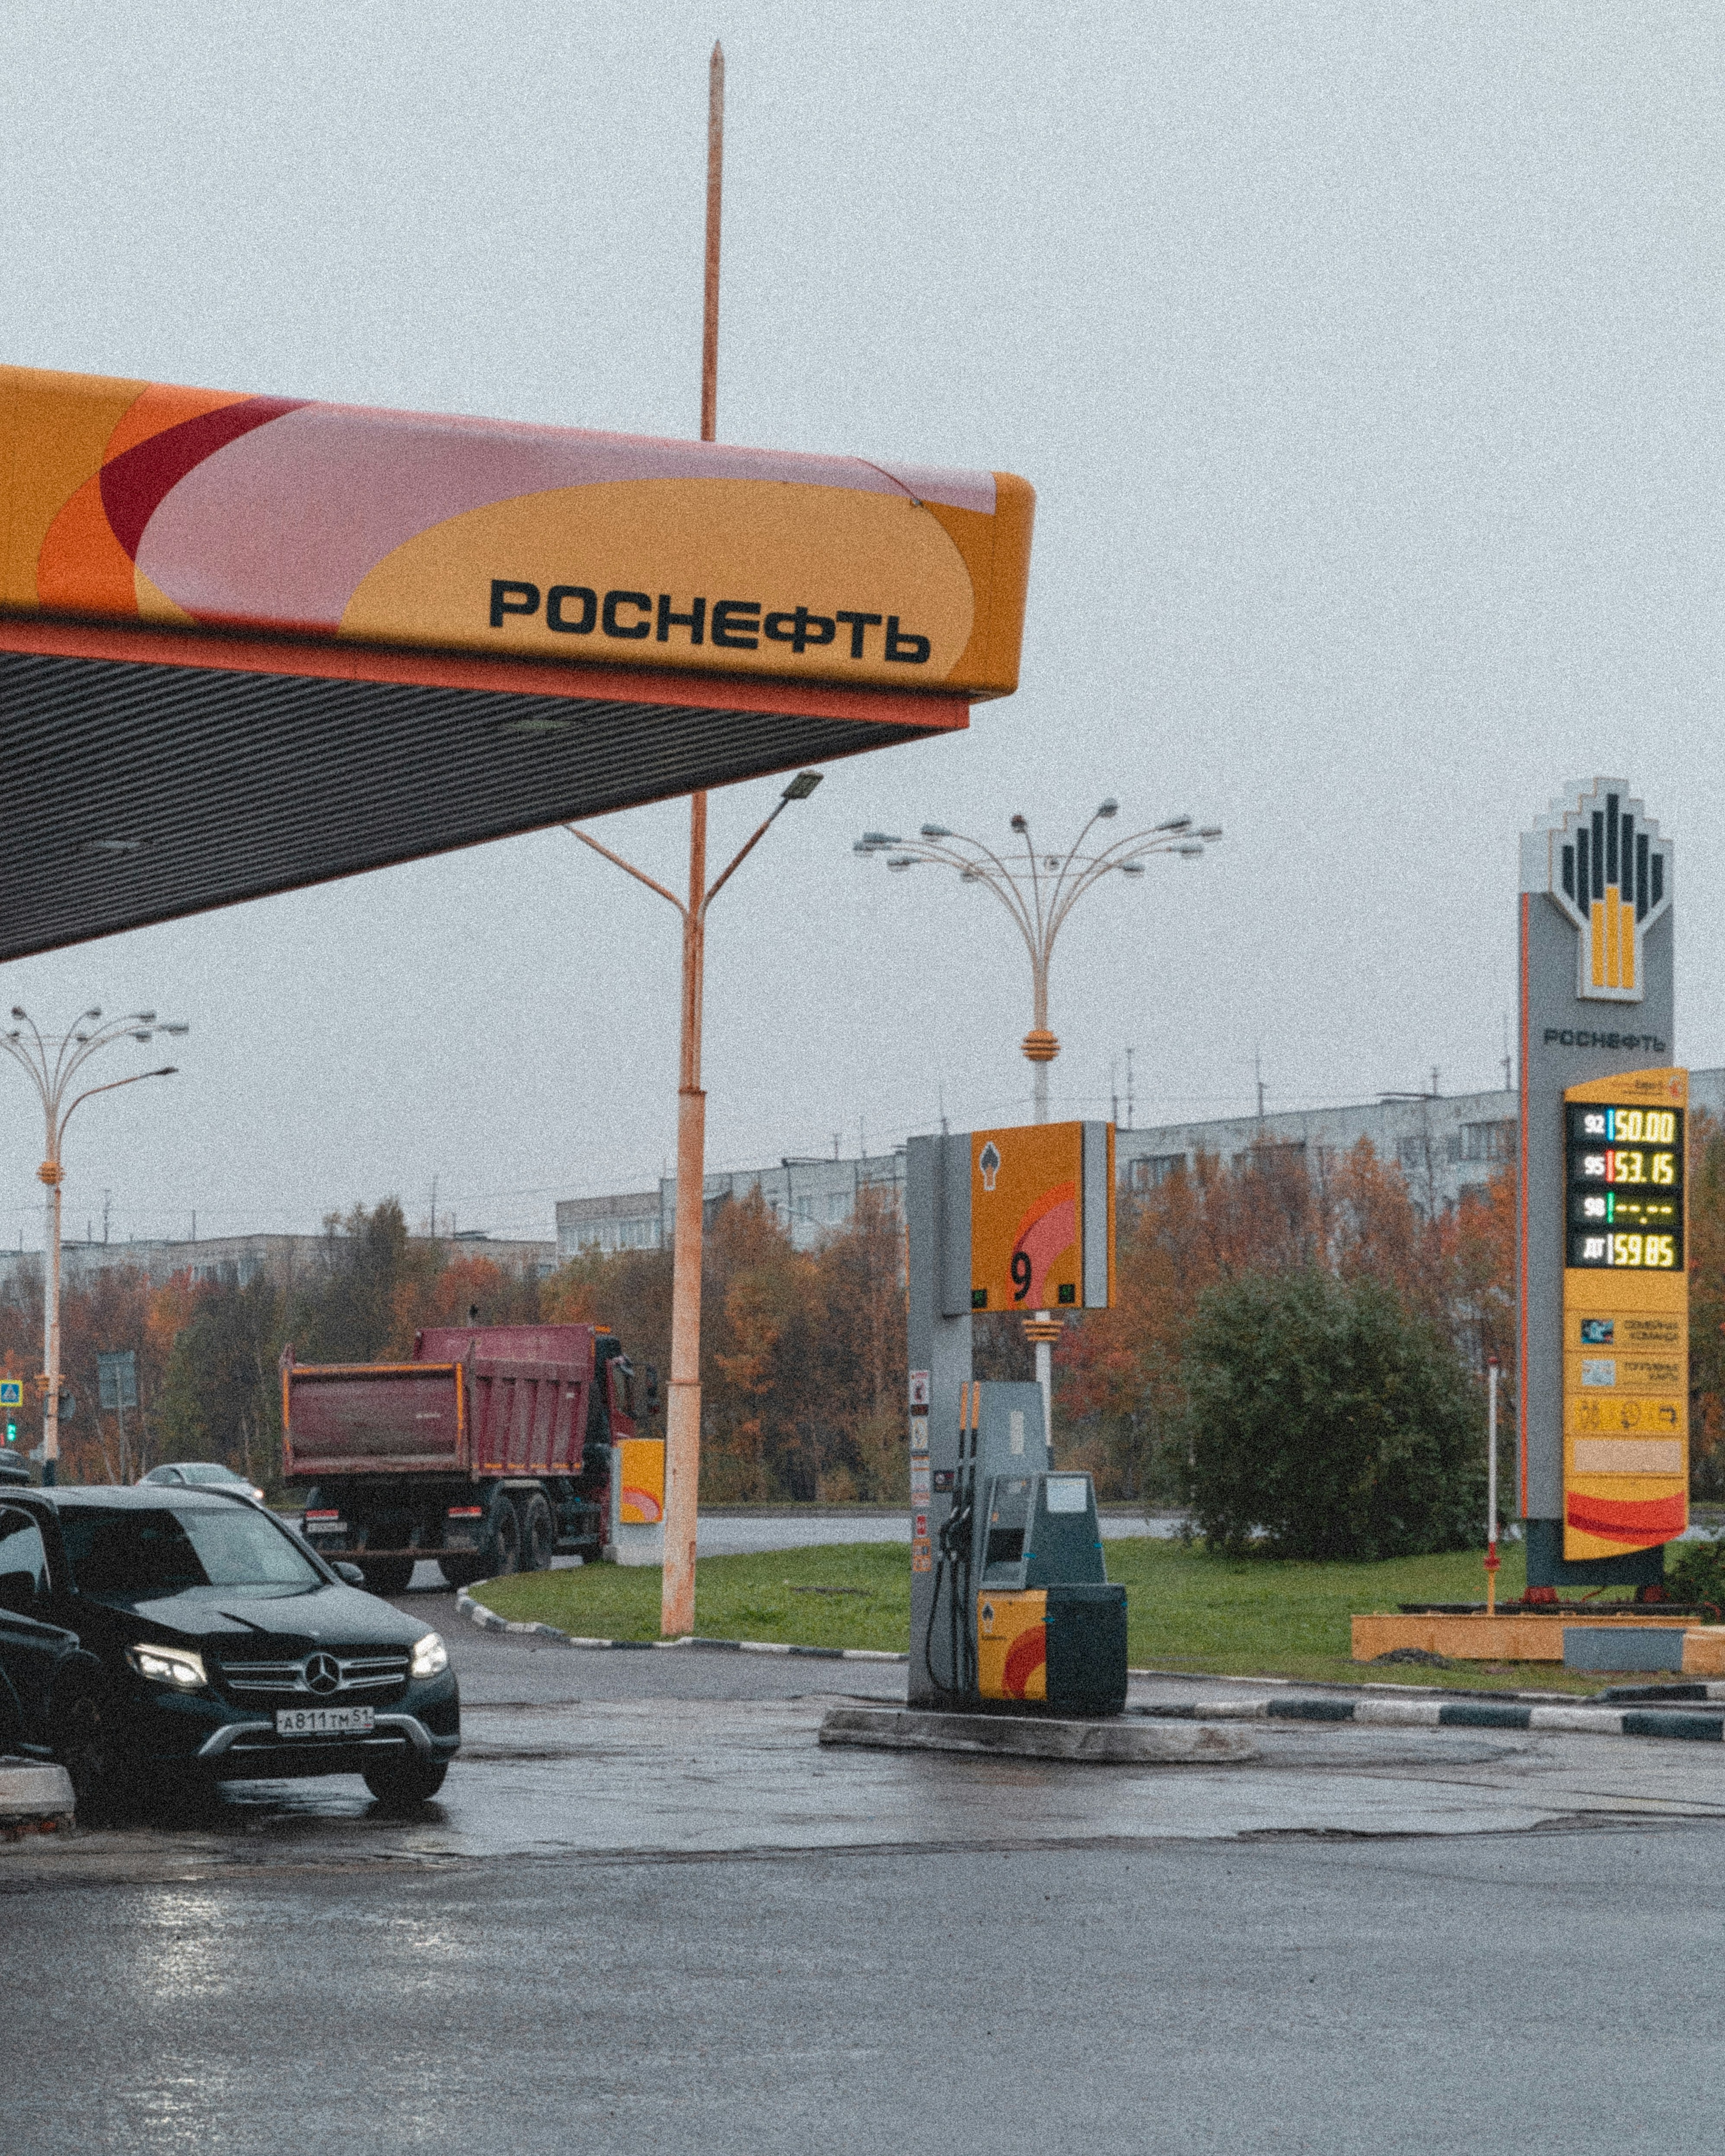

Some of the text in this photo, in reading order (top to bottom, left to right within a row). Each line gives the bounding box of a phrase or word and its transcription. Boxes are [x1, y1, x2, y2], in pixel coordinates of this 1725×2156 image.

[489, 579, 931, 664] РОСНЕФТЬ
[1543, 1028, 1667, 1052] РОСНЕФТЬ
[1584, 1110, 1675, 1144] 92 50.00
[1584, 1151, 1674, 1185] 95 53.15
[1584, 1197, 1606, 1217] 98
[1583, 1237, 1606, 1259] ДТ
[1010, 1251, 1032, 1302] 9
